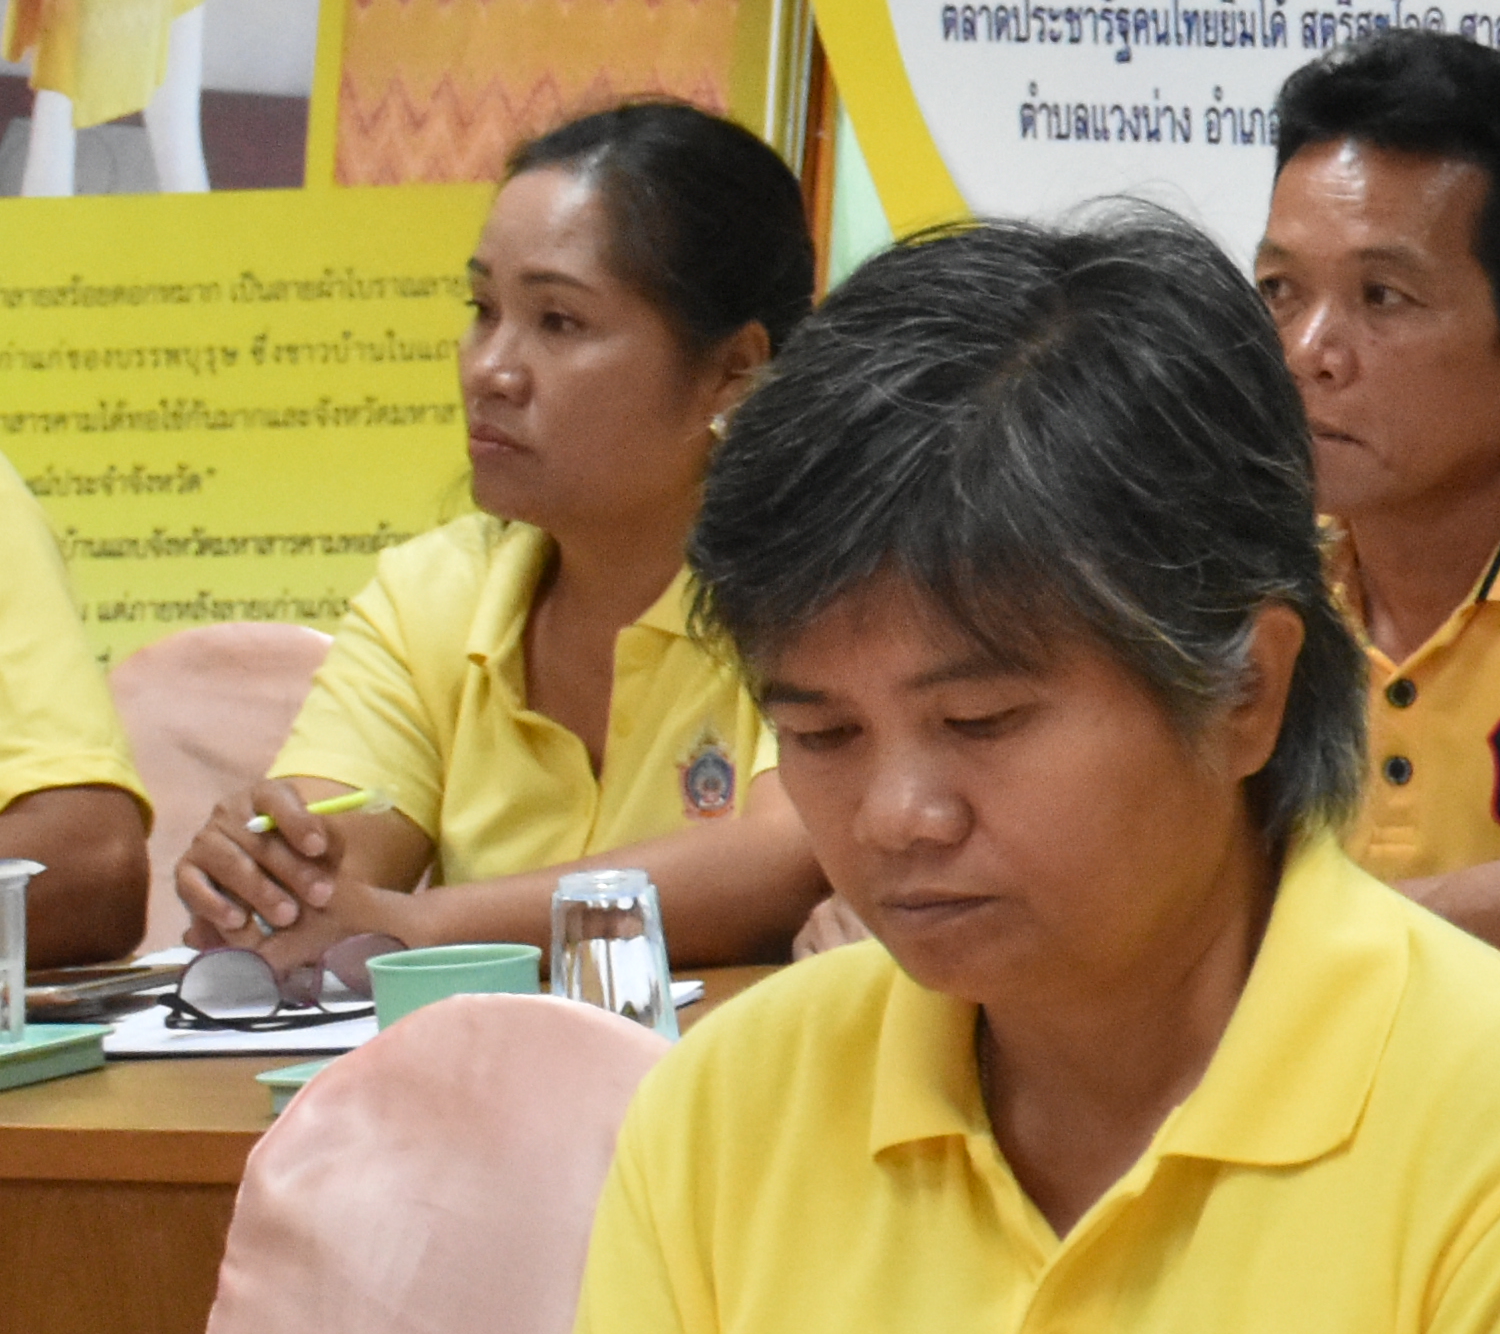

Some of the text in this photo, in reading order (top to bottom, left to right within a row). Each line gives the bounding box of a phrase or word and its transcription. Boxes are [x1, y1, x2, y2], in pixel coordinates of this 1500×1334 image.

[1019, 81, 1193, 144] ตำบลแวงน่าง
